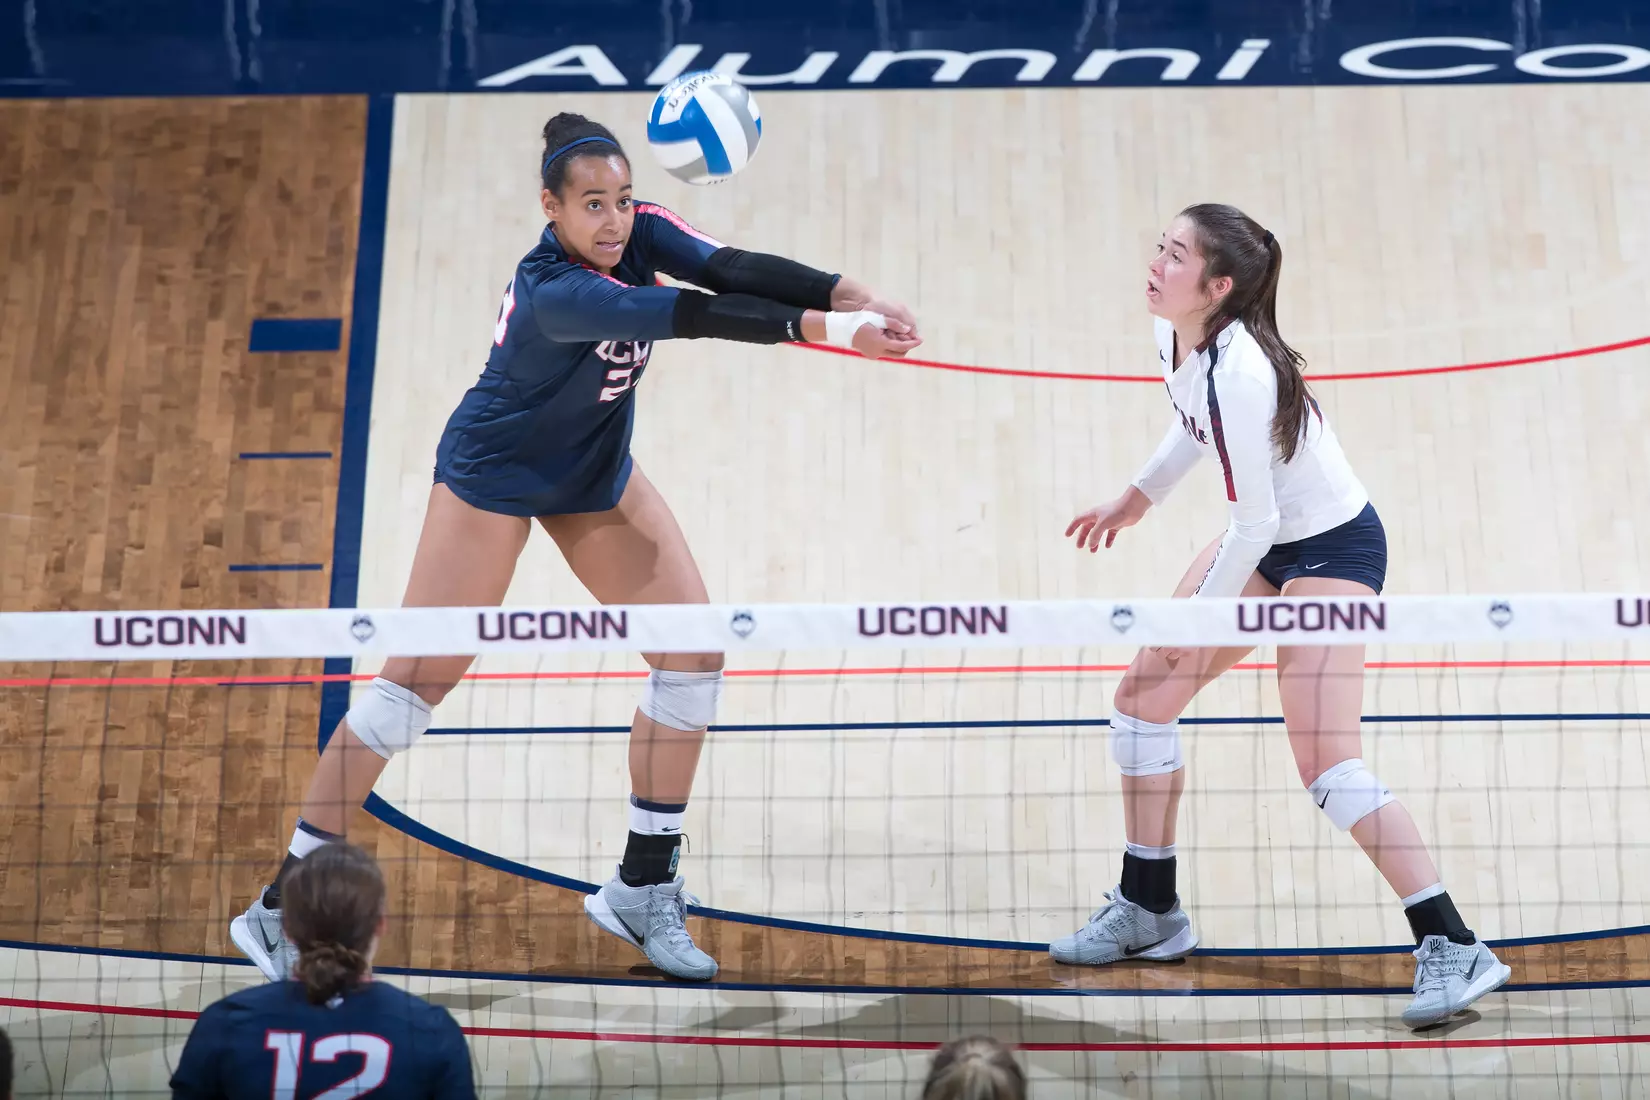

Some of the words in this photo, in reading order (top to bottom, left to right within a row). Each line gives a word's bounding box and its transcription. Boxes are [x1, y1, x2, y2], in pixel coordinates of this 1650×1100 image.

[477, 39, 1270, 86] Alumni
[1338, 36, 1650, 79] Co
[94, 616, 246, 648] UCONN
[477, 610, 628, 642] UCONN
[858, 605, 1008, 637] UCONN
[1237, 602, 1386, 633] UCONN
[1616, 598, 1650, 628] U
[264, 1029, 393, 1100] 12
